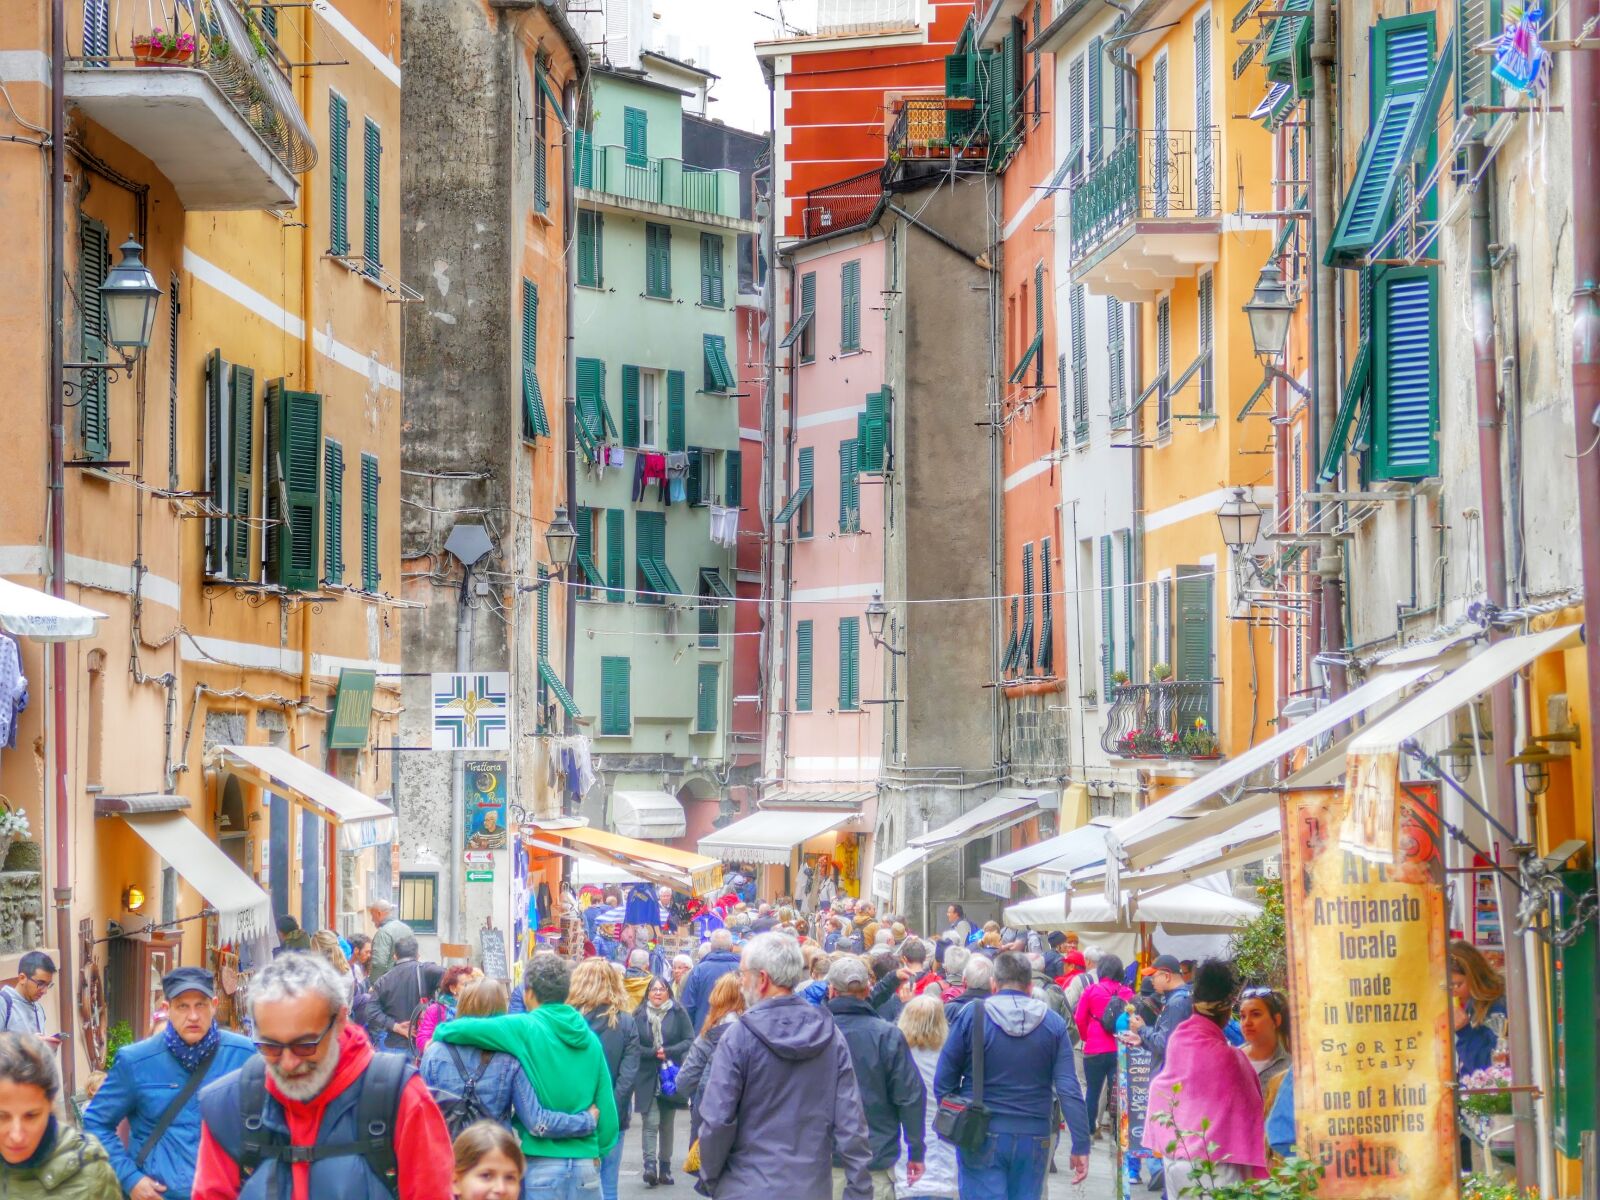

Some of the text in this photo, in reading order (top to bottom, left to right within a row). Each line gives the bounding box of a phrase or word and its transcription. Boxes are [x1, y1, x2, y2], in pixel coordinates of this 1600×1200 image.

[467, 762, 502, 772] Trattoria
[1314, 893, 1420, 929] Artigianato
[1339, 930, 1397, 960] locale
[1349, 973, 1391, 997] made
[1324, 1001, 1417, 1025] in Vernazza
[1325, 1056, 1416, 1073] in Italy
[1323, 1083, 1427, 1110] one of a kind
[1328, 1110, 1425, 1136] accessories
